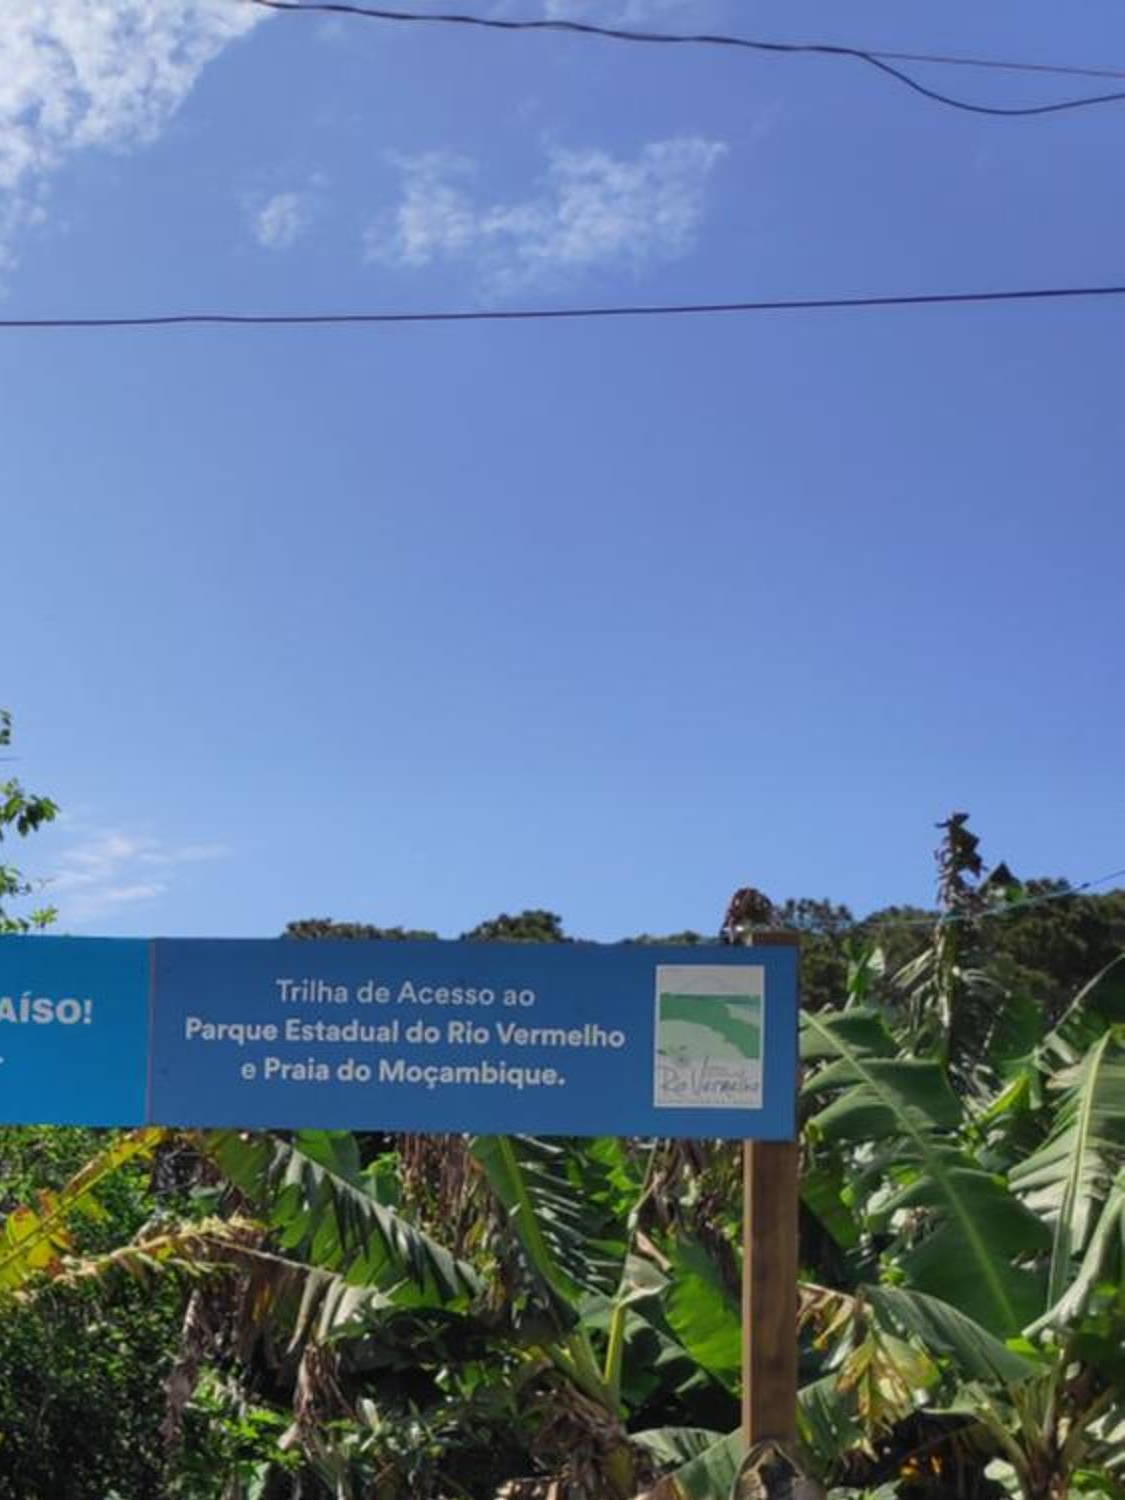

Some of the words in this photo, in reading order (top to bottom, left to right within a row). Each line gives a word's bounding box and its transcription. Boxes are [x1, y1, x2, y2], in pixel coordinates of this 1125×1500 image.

[276, 979, 348, 1003] Trilha
[356, 981, 391, 1004] de
[397, 981, 495, 1006] Acesso
[503, 988, 536, 1007] ao
[185, 1017, 278, 1046] Parque
[285, 1018, 399, 1044] Estadual
[405, 1020, 441, 1045] do
[447, 1021, 491, 1045] Rio
[495, 1022, 626, 1048] Vermelho
[241, 1062, 257, 1080] e
[264, 1057, 330, 1081] Praia
[336, 1058, 372, 1083] do
[378, 1059, 566, 1090] Moçambique.
